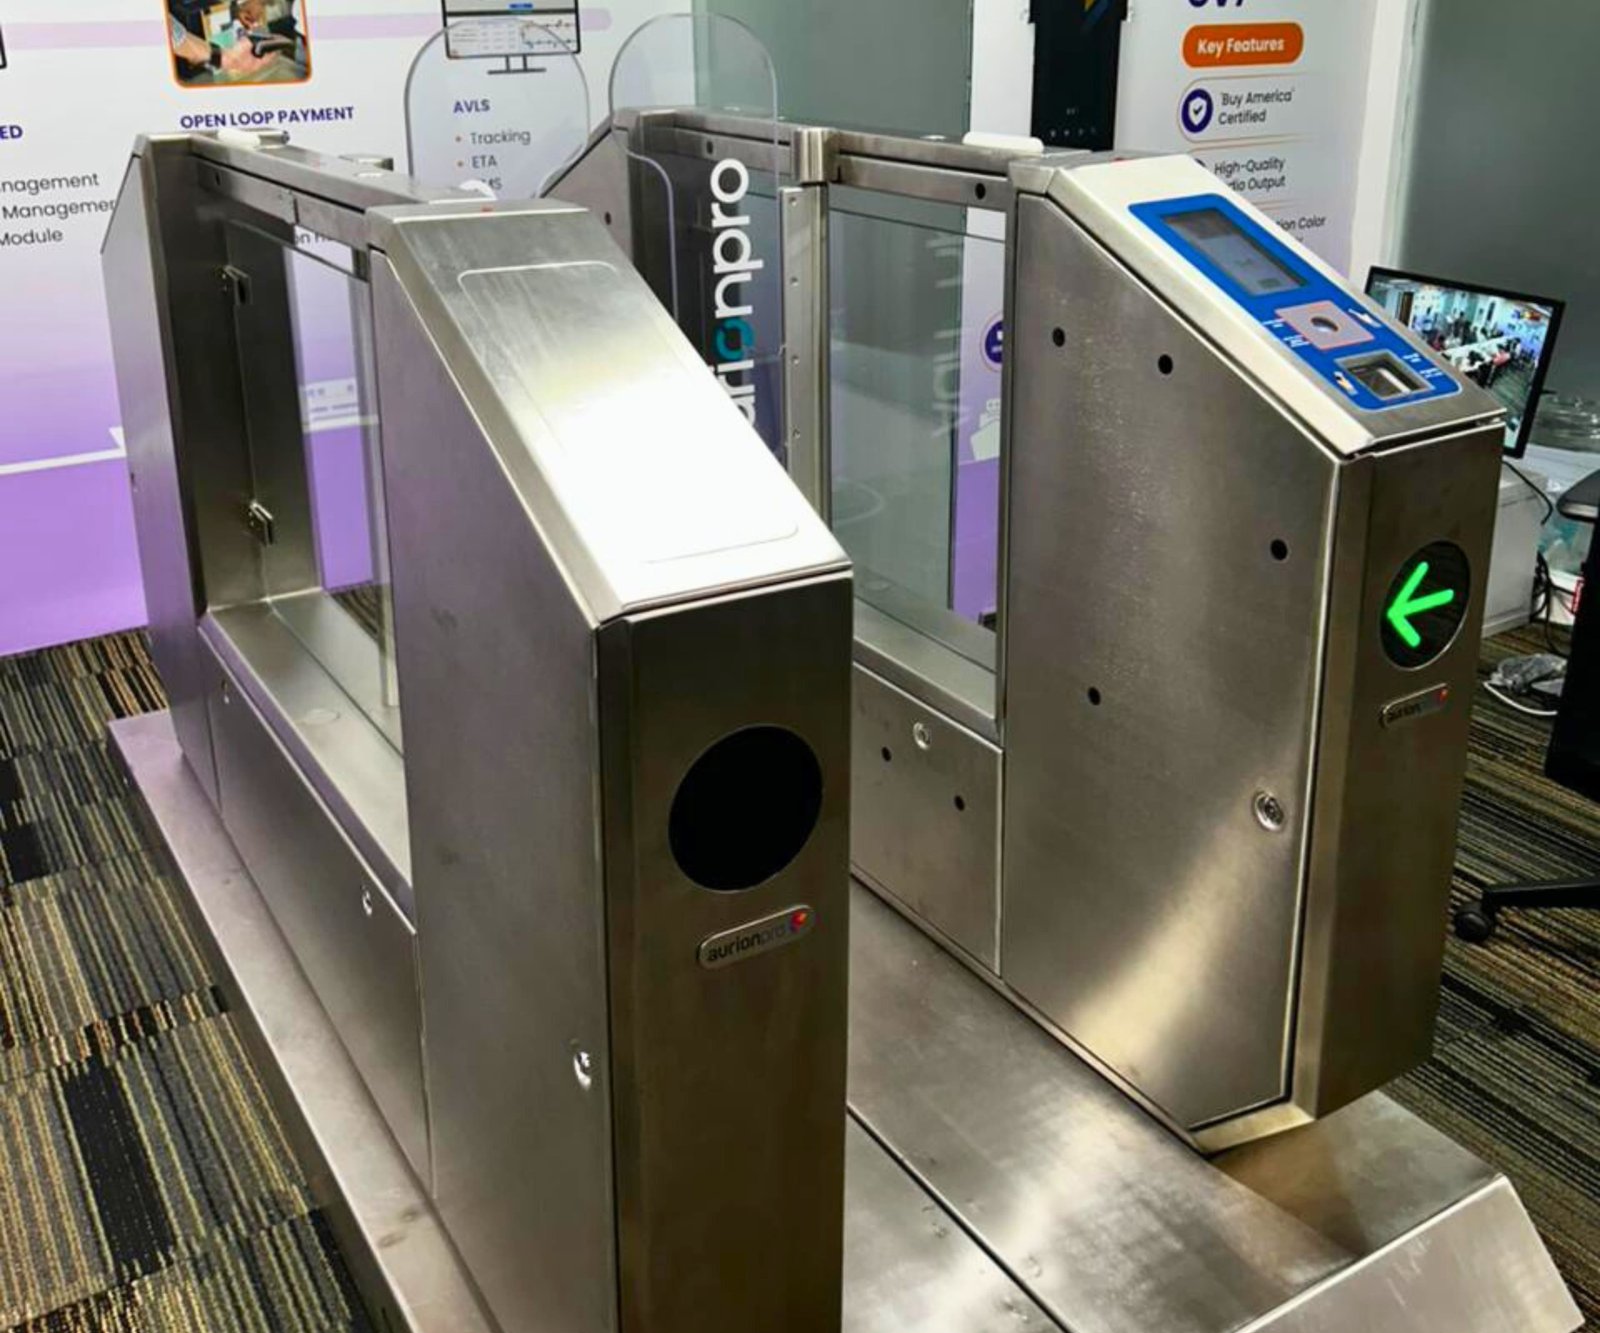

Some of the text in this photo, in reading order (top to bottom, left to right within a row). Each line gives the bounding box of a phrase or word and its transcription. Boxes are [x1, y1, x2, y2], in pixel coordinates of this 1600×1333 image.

[1197, 37, 1285, 59] Key Features
[453, 98, 491, 114] AVLS
[180, 106, 355, 129] OPEN LOOP PAYMENT
[1218, 108, 1267, 126] Certified
[471, 128, 532, 147] Tracking
[471, 154, 498, 169] ETA
[1214, 157, 1286, 179] High-Quality
[1248, 175, 1286, 192] Output
[1298, 214, 1328, 230] Color
[0, 227, 64, 247] Module
[707, 925, 786, 962] aurionpro
